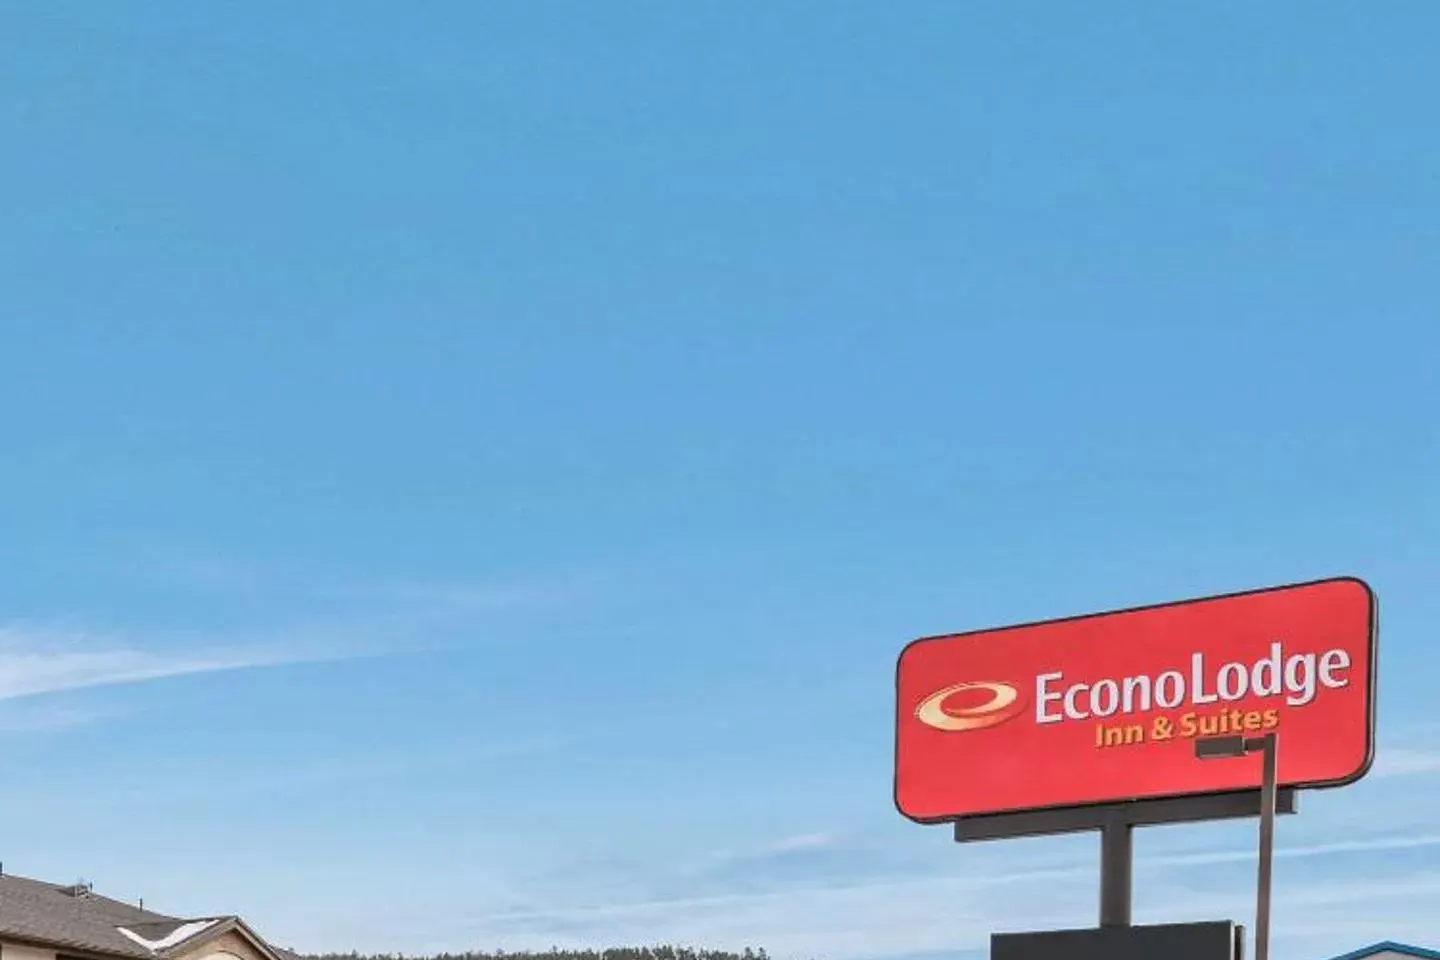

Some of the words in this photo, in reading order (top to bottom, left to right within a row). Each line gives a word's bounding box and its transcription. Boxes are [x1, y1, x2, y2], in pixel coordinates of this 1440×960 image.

[1035, 641, 1351, 724] EconoLodge
[1095, 723, 1144, 748] Inn
[1151, 717, 1174, 741] &
[1180, 707, 1279, 737] Suites
